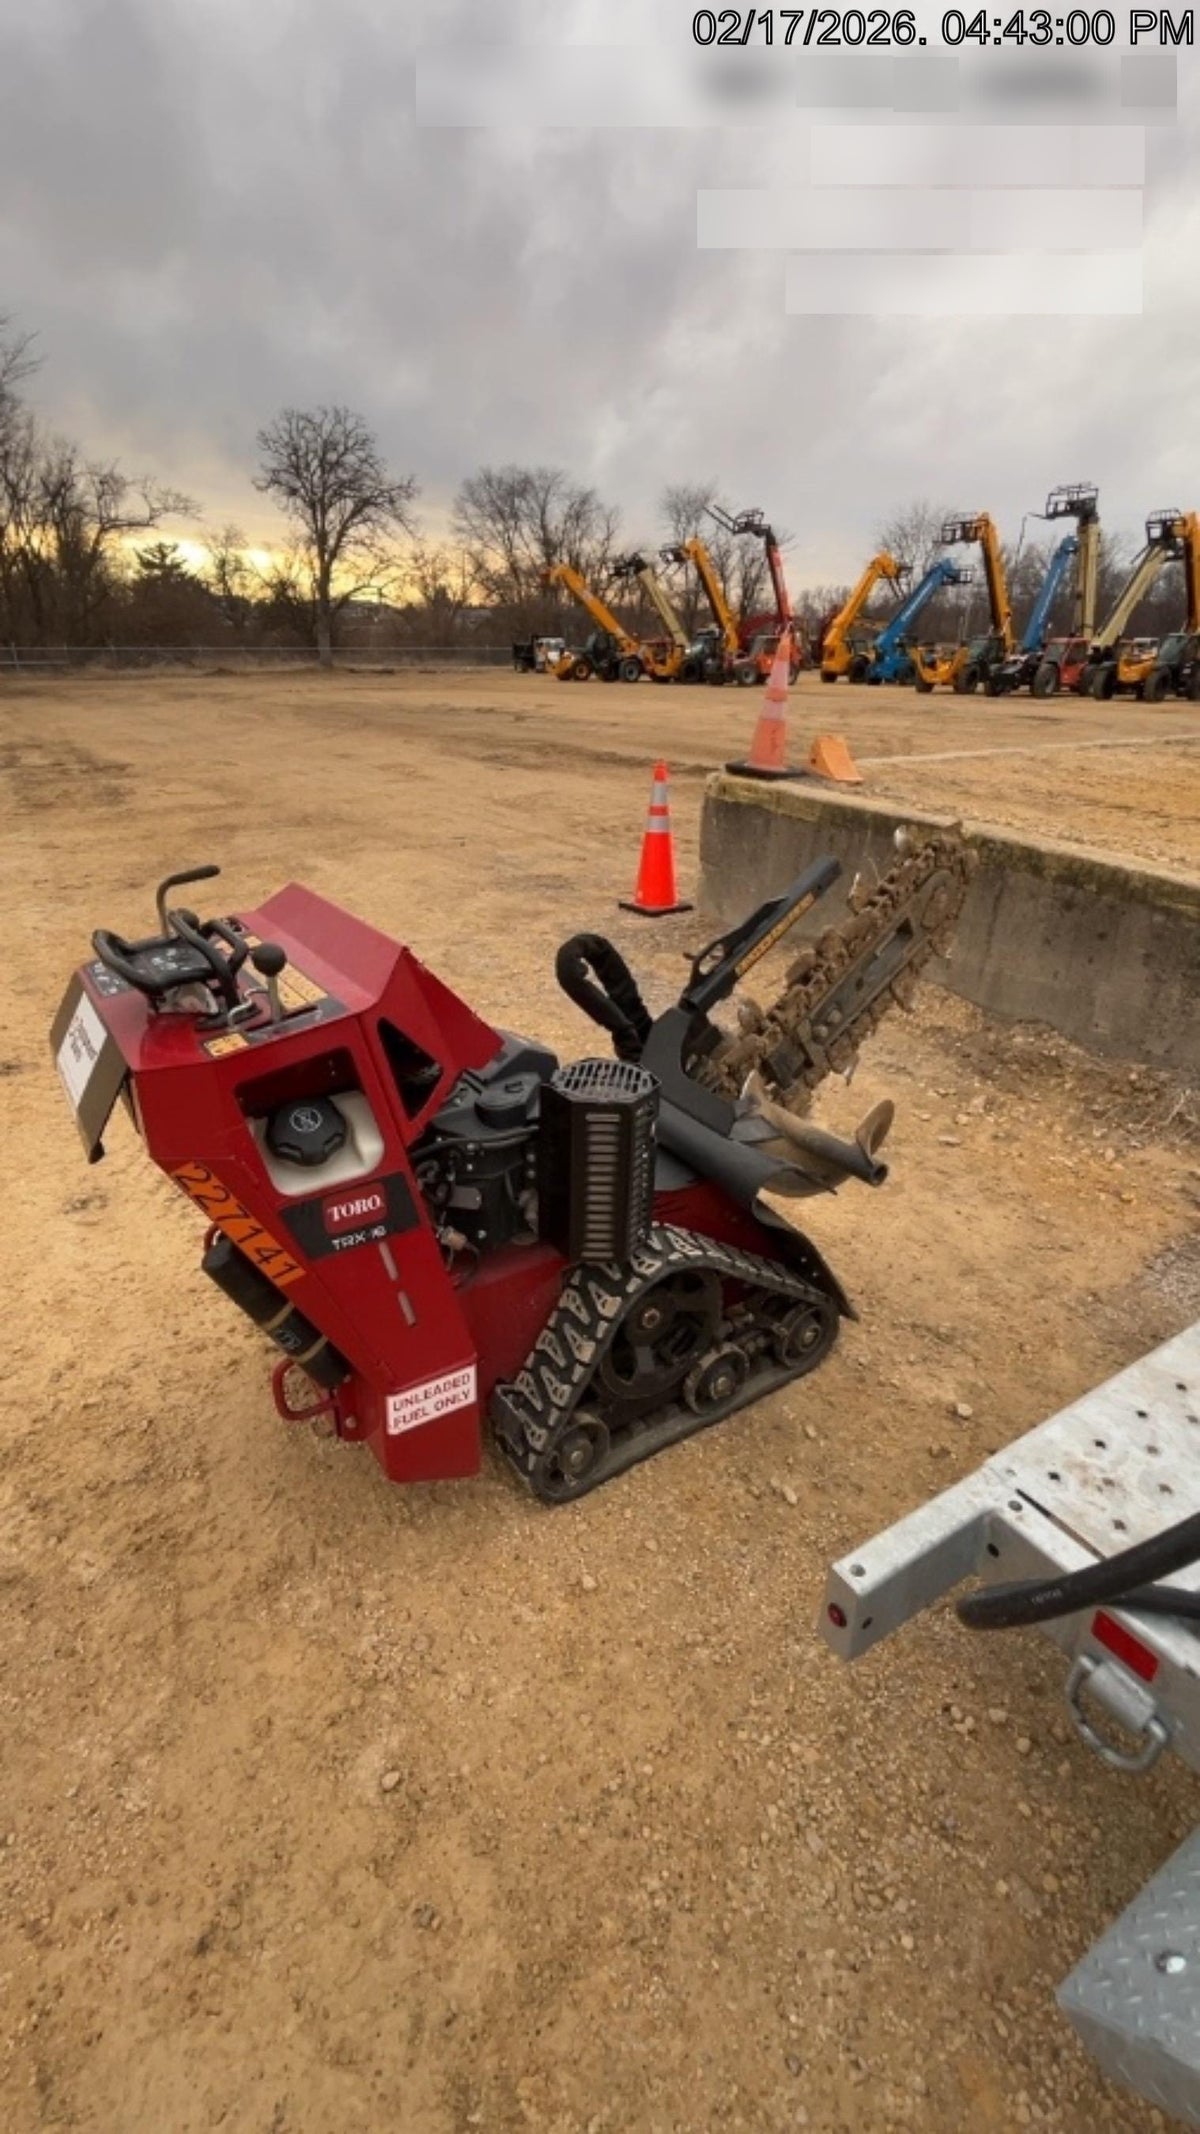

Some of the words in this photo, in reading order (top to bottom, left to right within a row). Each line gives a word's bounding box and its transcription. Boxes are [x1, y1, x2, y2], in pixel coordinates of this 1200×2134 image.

[175, 1163, 299, 1280] 227141
[327, 1194, 382, 1221] TORO
[393, 1373, 470, 1412] UNLEADED
[393, 1406, 429, 1430] FUEL
[434, 1388, 470, 1411] ONLY
